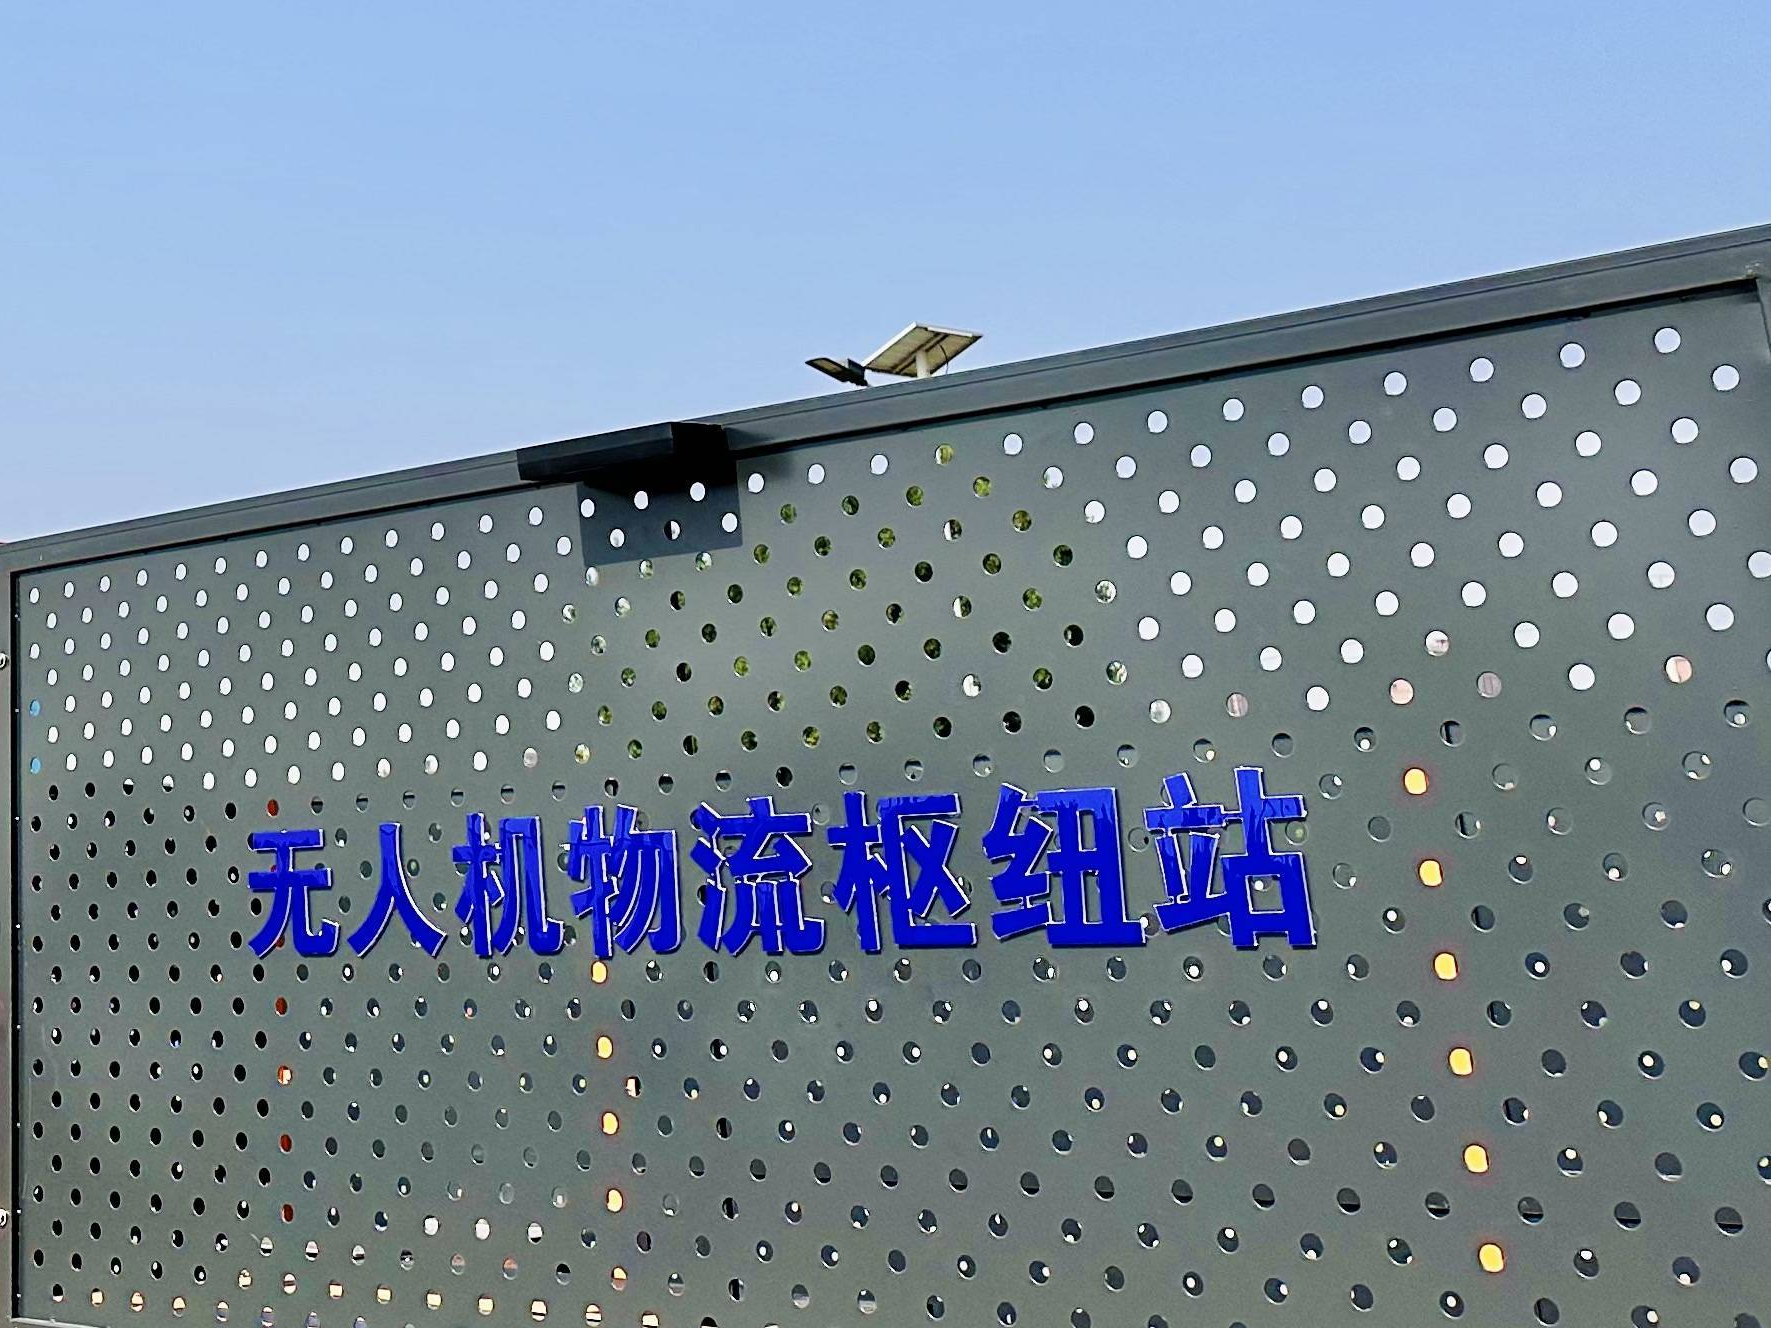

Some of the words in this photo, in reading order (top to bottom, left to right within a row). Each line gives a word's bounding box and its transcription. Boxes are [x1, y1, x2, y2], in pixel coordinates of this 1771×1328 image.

[247, 766, 1316, 960] 无人机物流枢纽站
